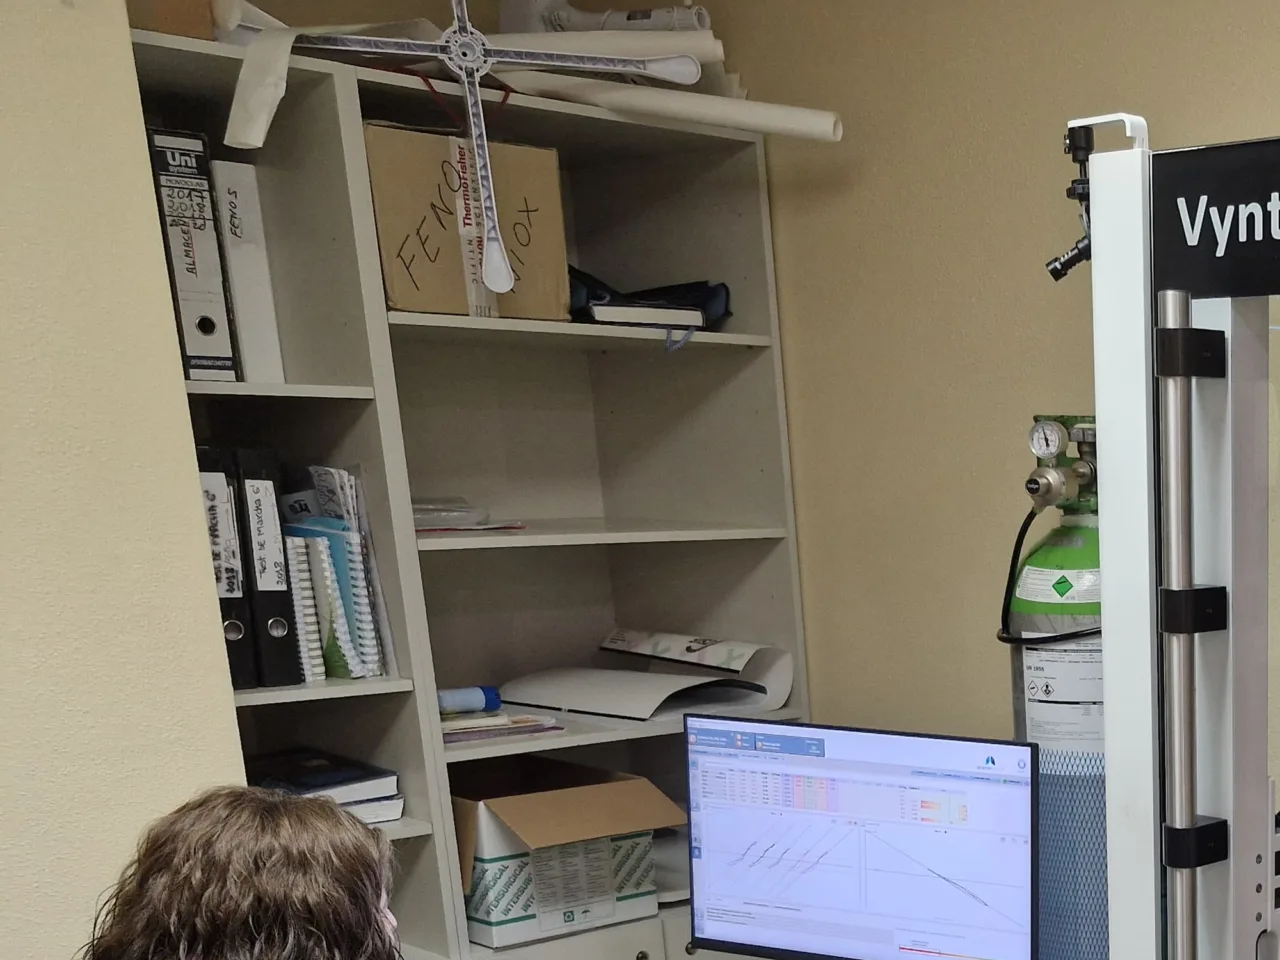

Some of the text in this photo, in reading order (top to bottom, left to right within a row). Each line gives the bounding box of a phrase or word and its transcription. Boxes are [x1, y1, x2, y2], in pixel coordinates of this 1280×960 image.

[166, 151, 197, 168] Uni
[168, 165, 198, 175] system
[167, 188, 207, 202] 2017
[457, 145, 473, 229] ThermoFisher
[396, 160, 462, 292] FENO
[224, 567, 236, 594] 2018
[273, 561, 284, 586] 2018
